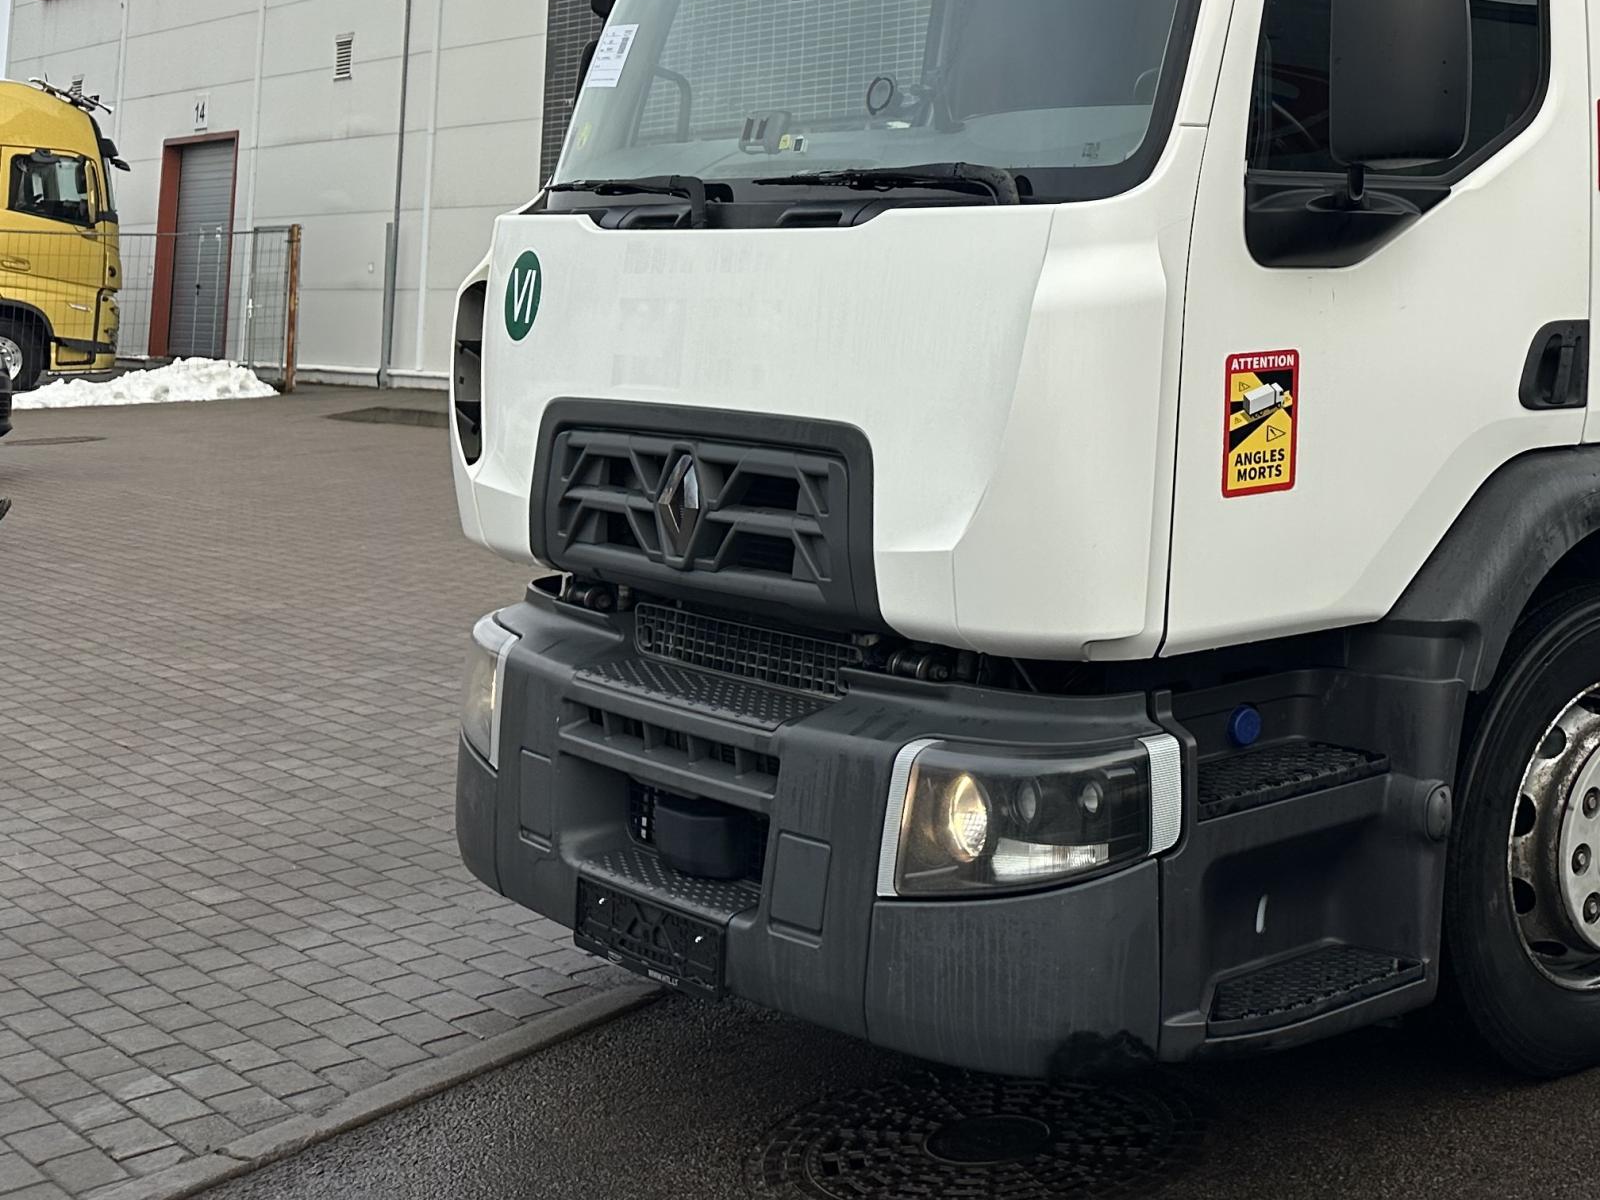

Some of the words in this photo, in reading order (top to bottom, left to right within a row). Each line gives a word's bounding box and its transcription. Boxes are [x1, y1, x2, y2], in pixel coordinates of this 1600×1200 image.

[195, 101, 206, 123] 14
[513, 267, 537, 324] VI
[1231, 354, 1295, 371] ATTENTION
[1234, 448, 1286, 467] ANGLES
[1236, 464, 1283, 483] MORTS
